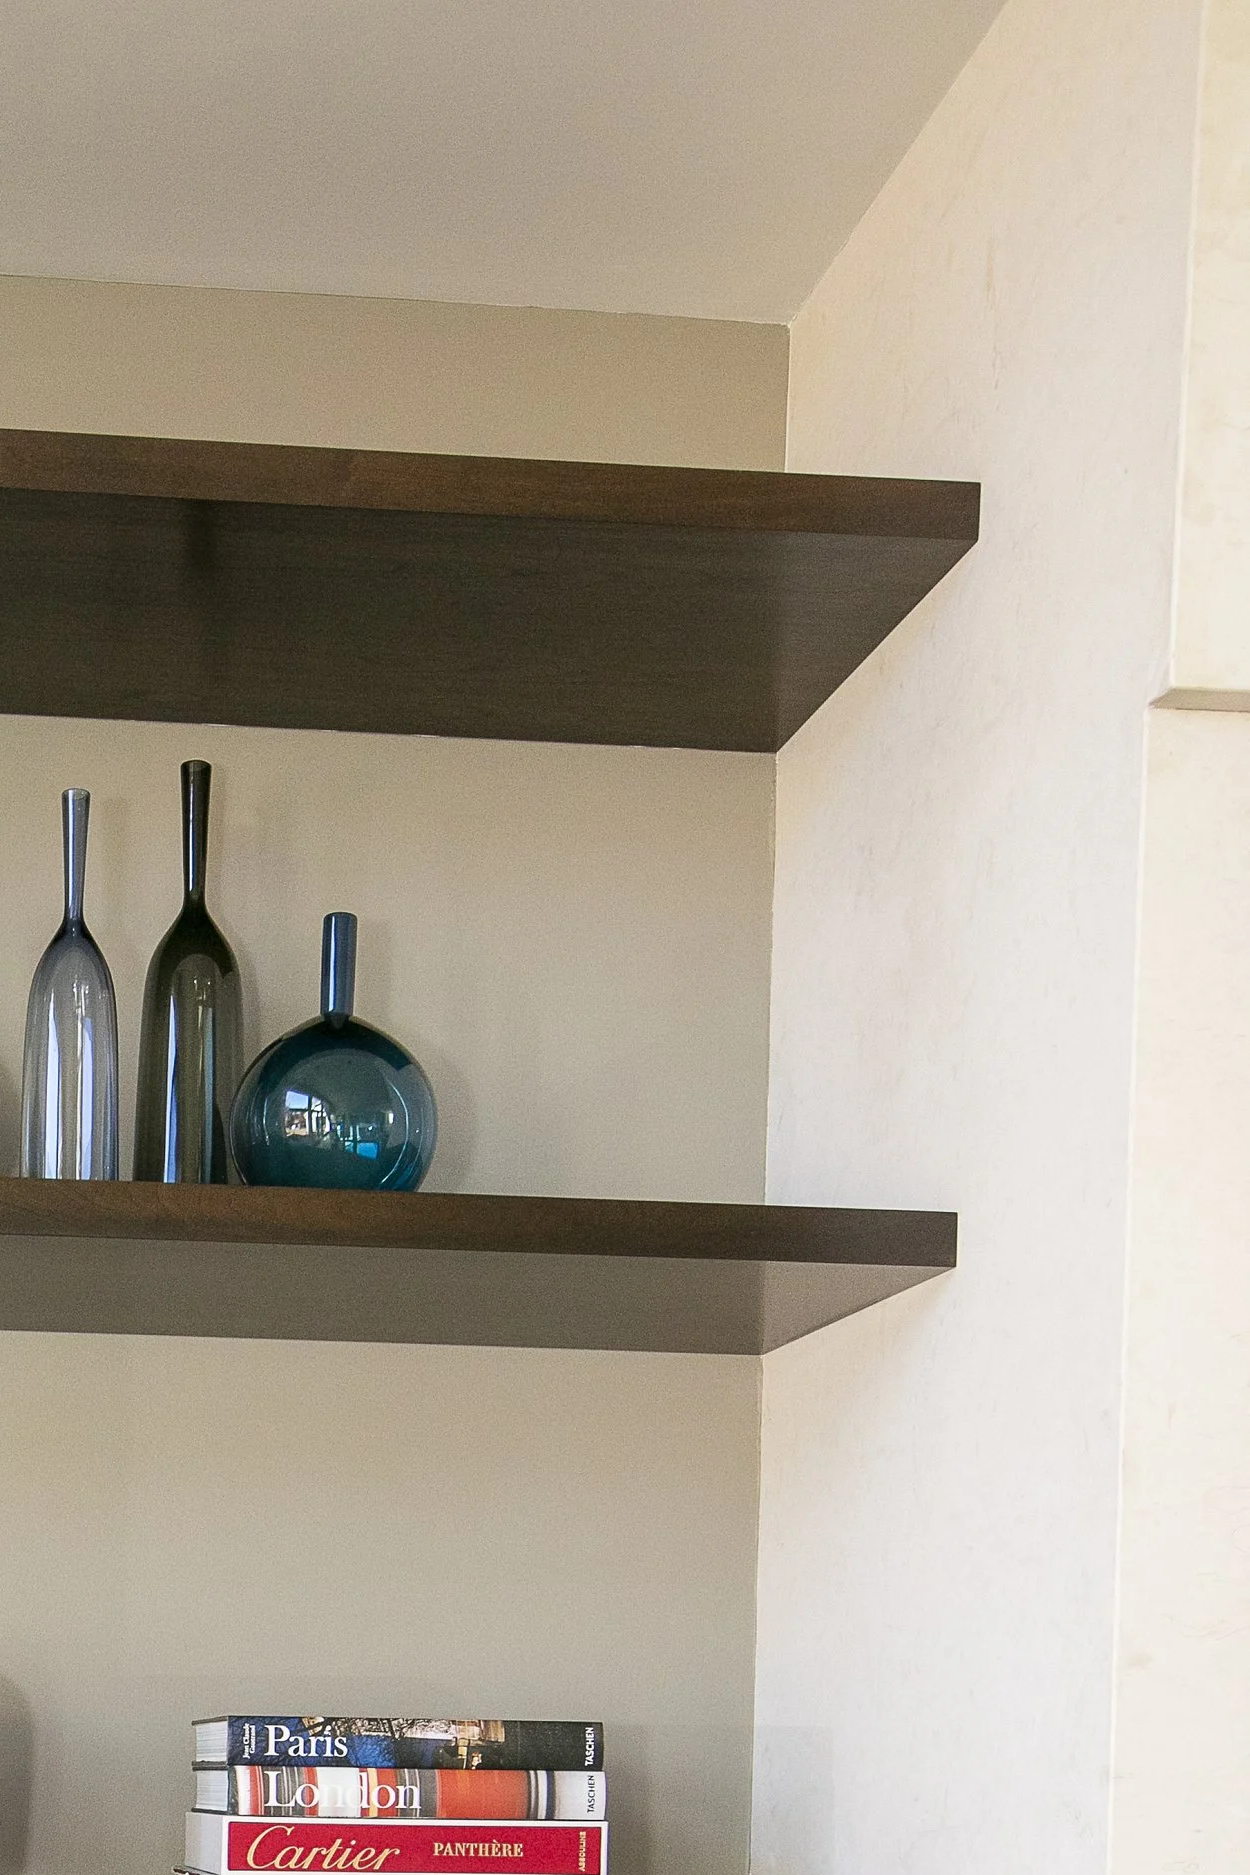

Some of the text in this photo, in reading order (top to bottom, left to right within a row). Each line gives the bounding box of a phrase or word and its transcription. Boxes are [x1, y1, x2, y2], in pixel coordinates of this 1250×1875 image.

[263, 1724, 349, 1758] Paris
[584, 1726, 595, 1767] TASCHEN
[263, 1770, 422, 1809] London
[586, 1774, 595, 1814] TASCHEN
[246, 1825, 401, 1871] Cartier
[433, 1839, 524, 1858] PANTHÈRE
